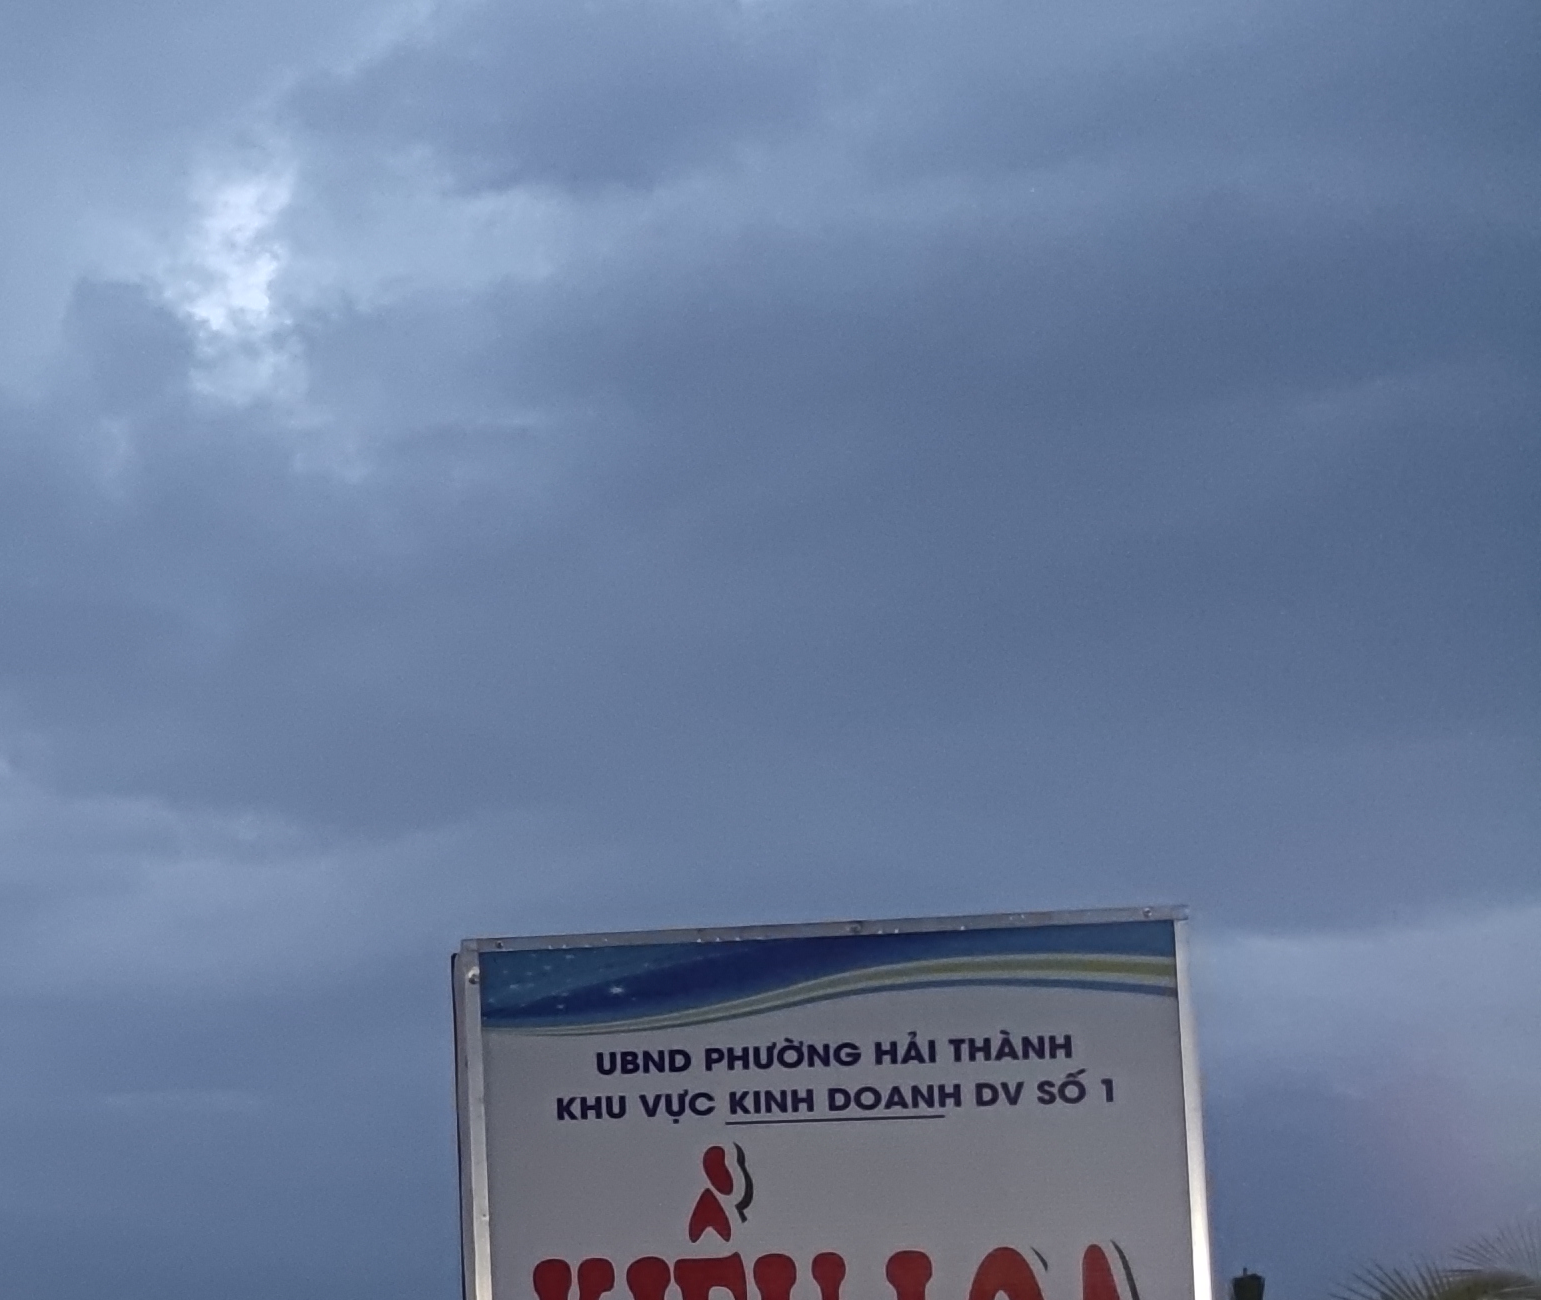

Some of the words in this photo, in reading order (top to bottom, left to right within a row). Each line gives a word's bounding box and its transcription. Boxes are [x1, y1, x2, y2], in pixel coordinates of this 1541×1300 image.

[595, 1048, 693, 1076] UBND
[704, 1036, 862, 1073] PHƯỜNG
[874, 1030, 937, 1065] HẢI
[948, 1029, 1073, 1062] THÀNH
[556, 1094, 628, 1121] KHU
[638, 1090, 717, 1125] VỰC
[728, 1086, 815, 1116] KINH
[827, 1081, 963, 1114] DOANH
[974, 1080, 1025, 1107] DV
[1036, 1068, 1089, 1105] SỐ
[1101, 1078, 1116, 1103] 1
